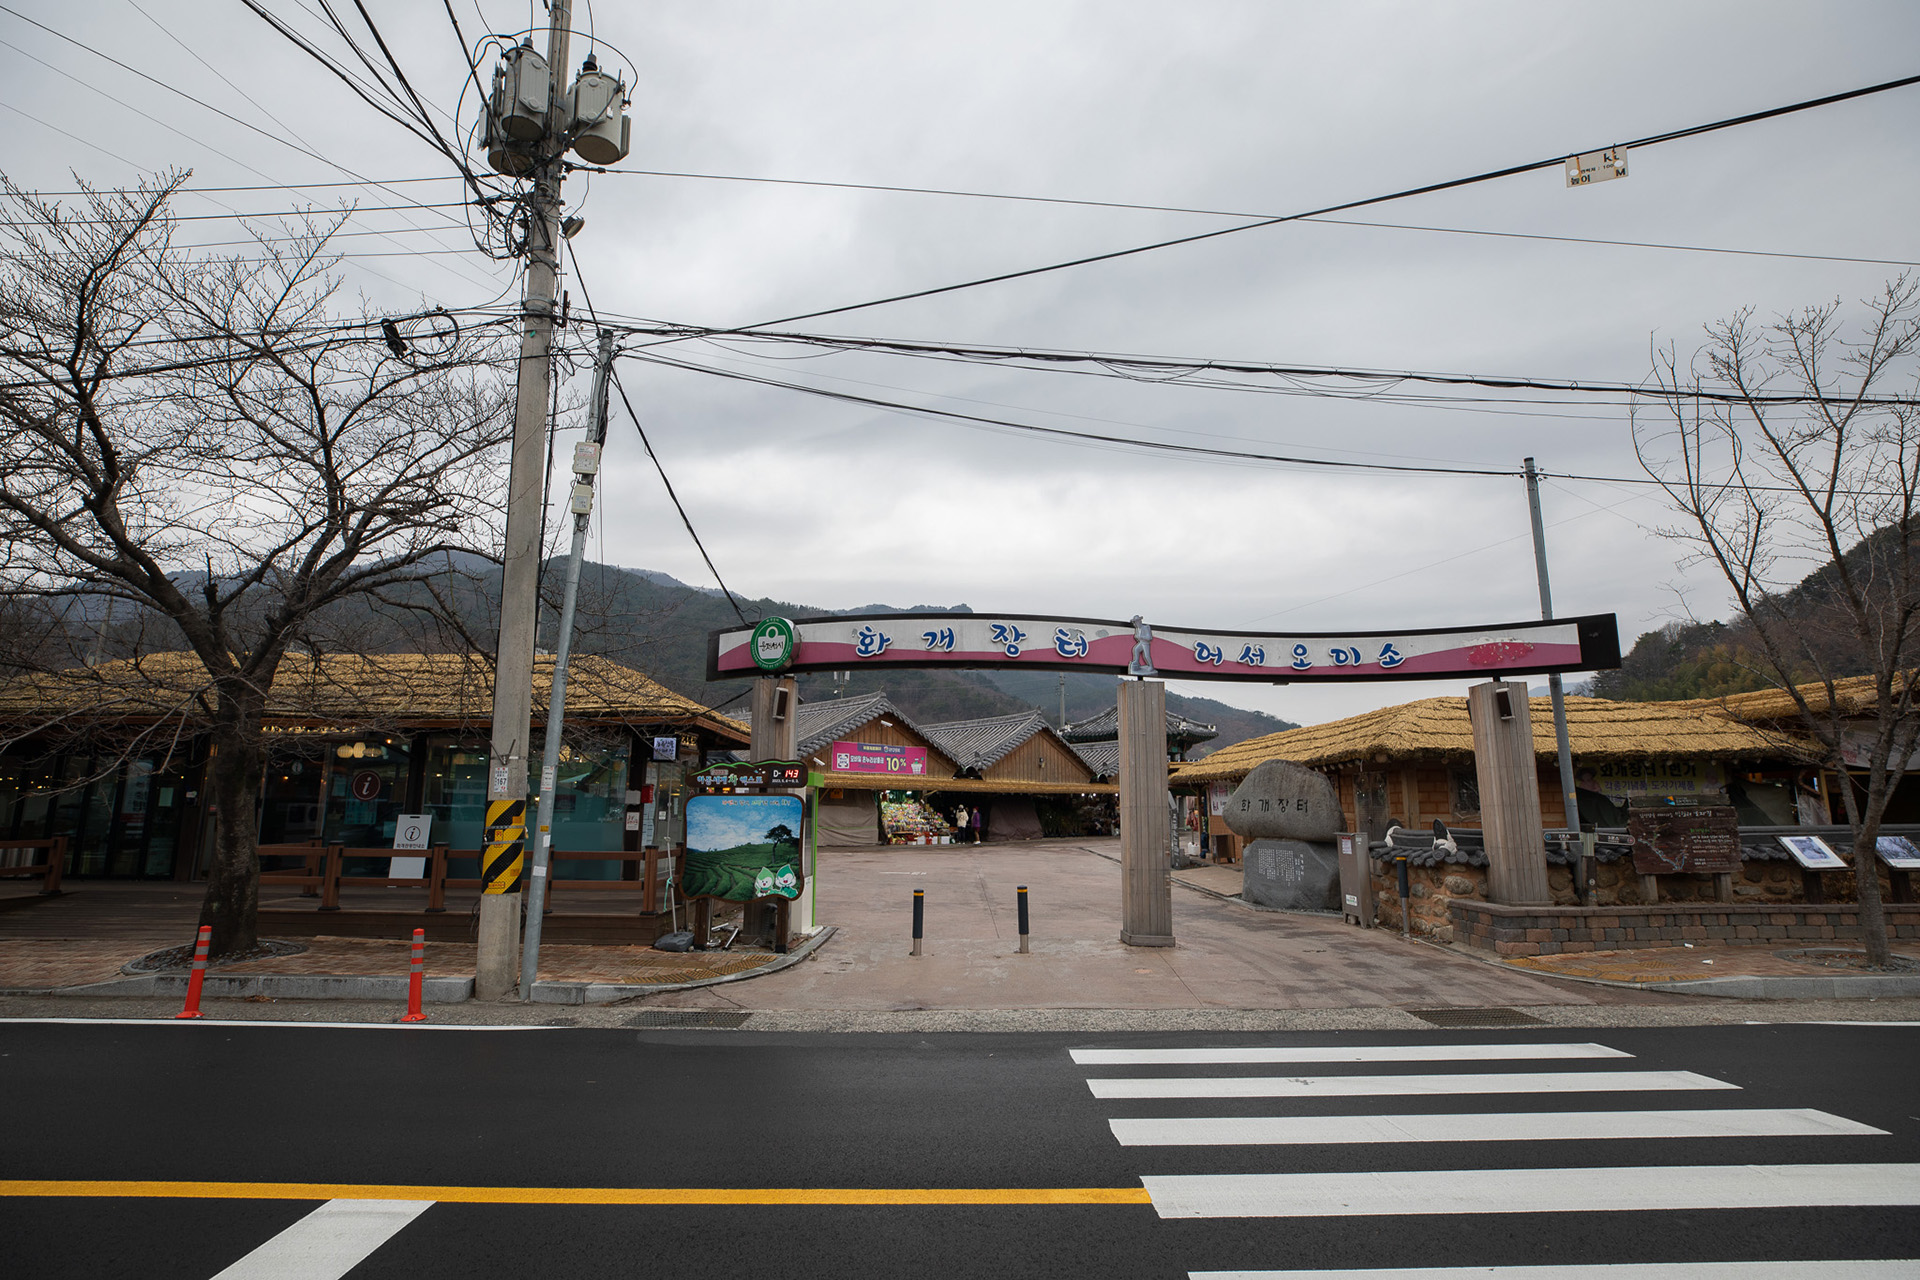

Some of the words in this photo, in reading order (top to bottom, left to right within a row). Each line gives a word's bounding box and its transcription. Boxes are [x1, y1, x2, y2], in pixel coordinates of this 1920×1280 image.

[1616, 168, 1626, 176] M
[856, 622, 1089, 659] 화개장터
[1194, 641, 1404, 671] 어서오이소
[784, 769, 800, 778] 143
[1240, 799, 1309, 813] 화개장터
